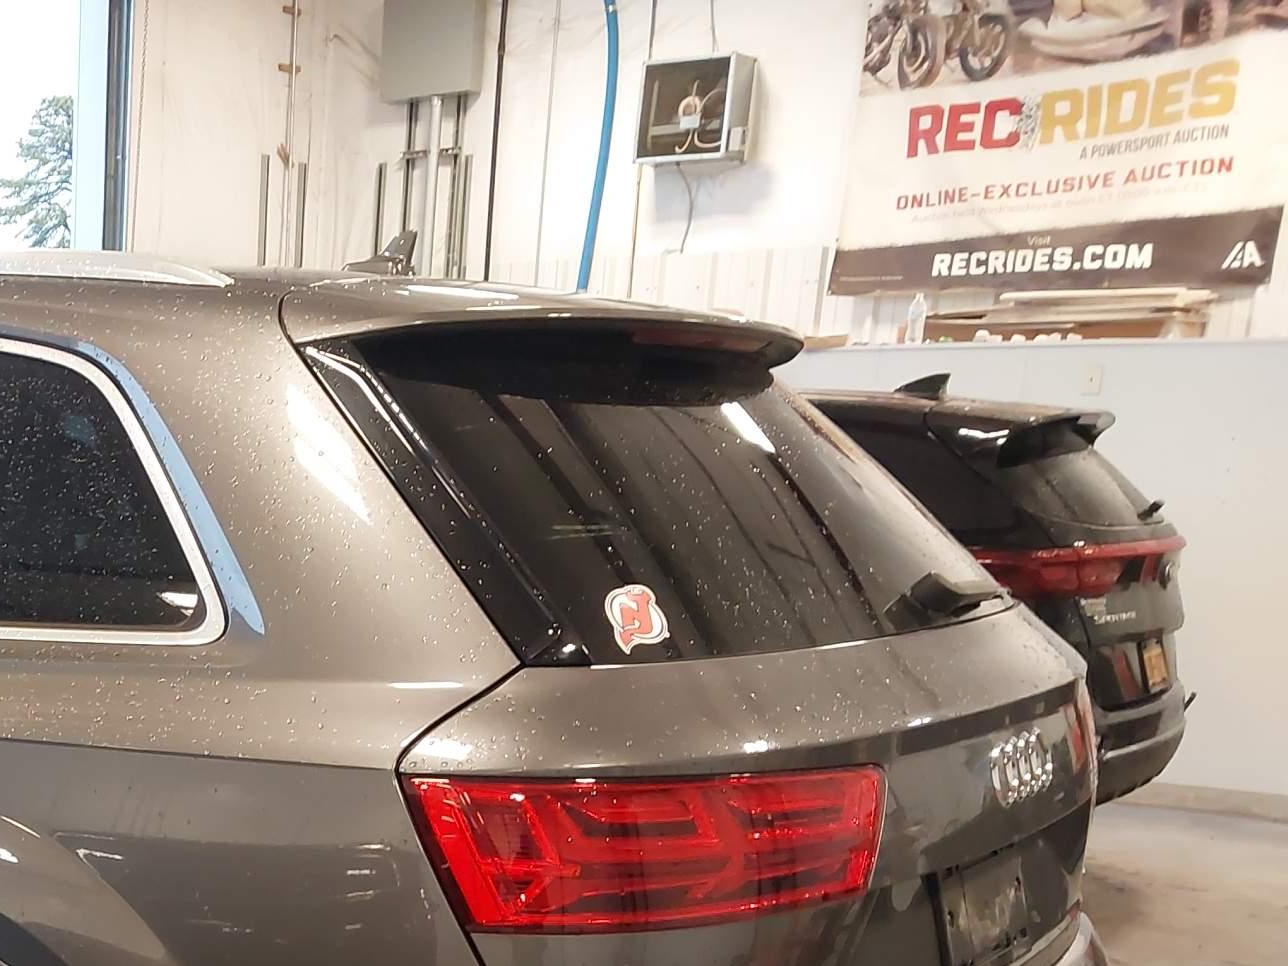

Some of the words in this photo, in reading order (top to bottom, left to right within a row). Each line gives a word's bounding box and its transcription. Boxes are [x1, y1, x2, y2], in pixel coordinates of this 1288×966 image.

[907, 97, 1022, 159] REC
[1038, 58, 1241, 145] RIDES
[1079, 145, 1090, 160] A
[1090, 131, 1171, 159] POWERSPORT
[1174, 123, 1230, 143] AUCTION
[896, 169, 1115, 211] ONLINE-EXCLUSIVE
[1123, 155, 1234, 185] AUCTION
[931, 242, 1154, 278] RECRIDES.COM
